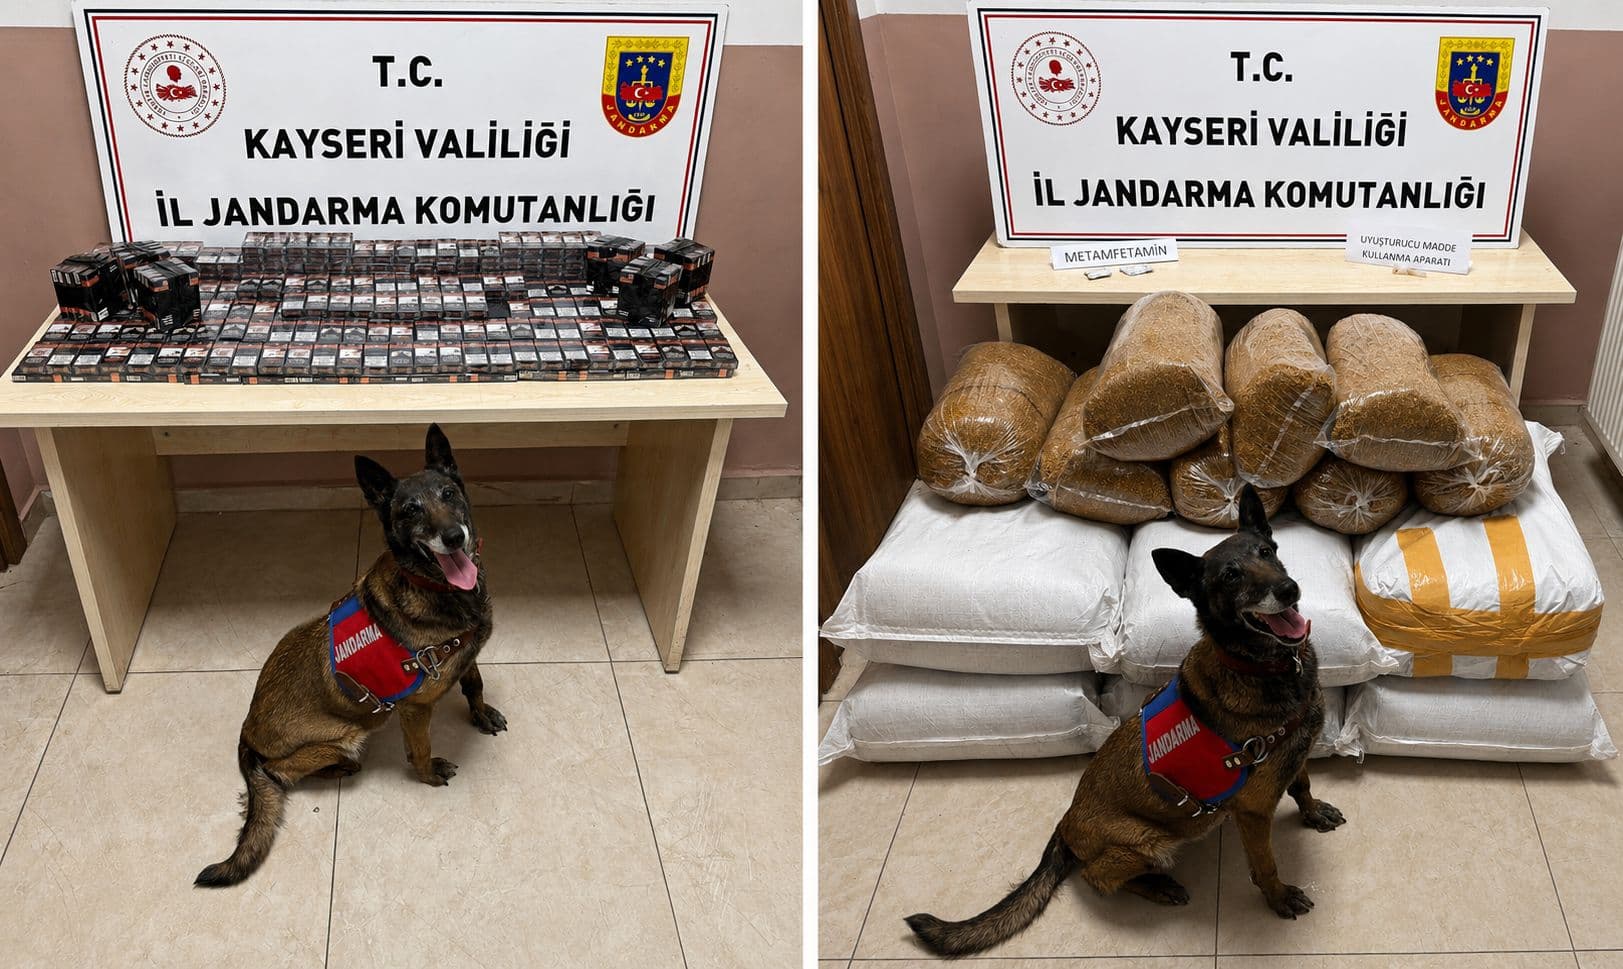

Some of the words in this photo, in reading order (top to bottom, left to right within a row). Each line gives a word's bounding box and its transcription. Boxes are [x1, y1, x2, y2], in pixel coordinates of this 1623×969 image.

[372, 55, 443, 88] T.C.
[1230, 51, 1293, 82] T.C.
[245, 120, 404, 159] KAYSERİ
[414, 120, 571, 159] VALİLİĞİ
[1116, 110, 1258, 146] KAYSERİ
[1267, 110, 1407, 147] VALİLİĞİ
[156, 189, 194, 227] İL
[203, 196, 406, 227] JANDARMA
[415, 189, 656, 225] KOMUTANLIĞI
[1033, 171, 1066, 207] İL
[1073, 179, 1256, 208] JANDARMA
[1264, 176, 1486, 209] KOMUTANLIĞI
[1064, 243, 1168, 263] METAMFETAMİN
[1360, 235, 1421, 250] UYUŞTURUCU
[1422, 241, 1456, 253] MADDE
[1362, 250, 1411, 263] KULLANMA
[1412, 254, 1451, 267] APARATI
[334, 623, 383, 663] JANDARMA
[1147, 715, 1200, 764] JANDARMA
